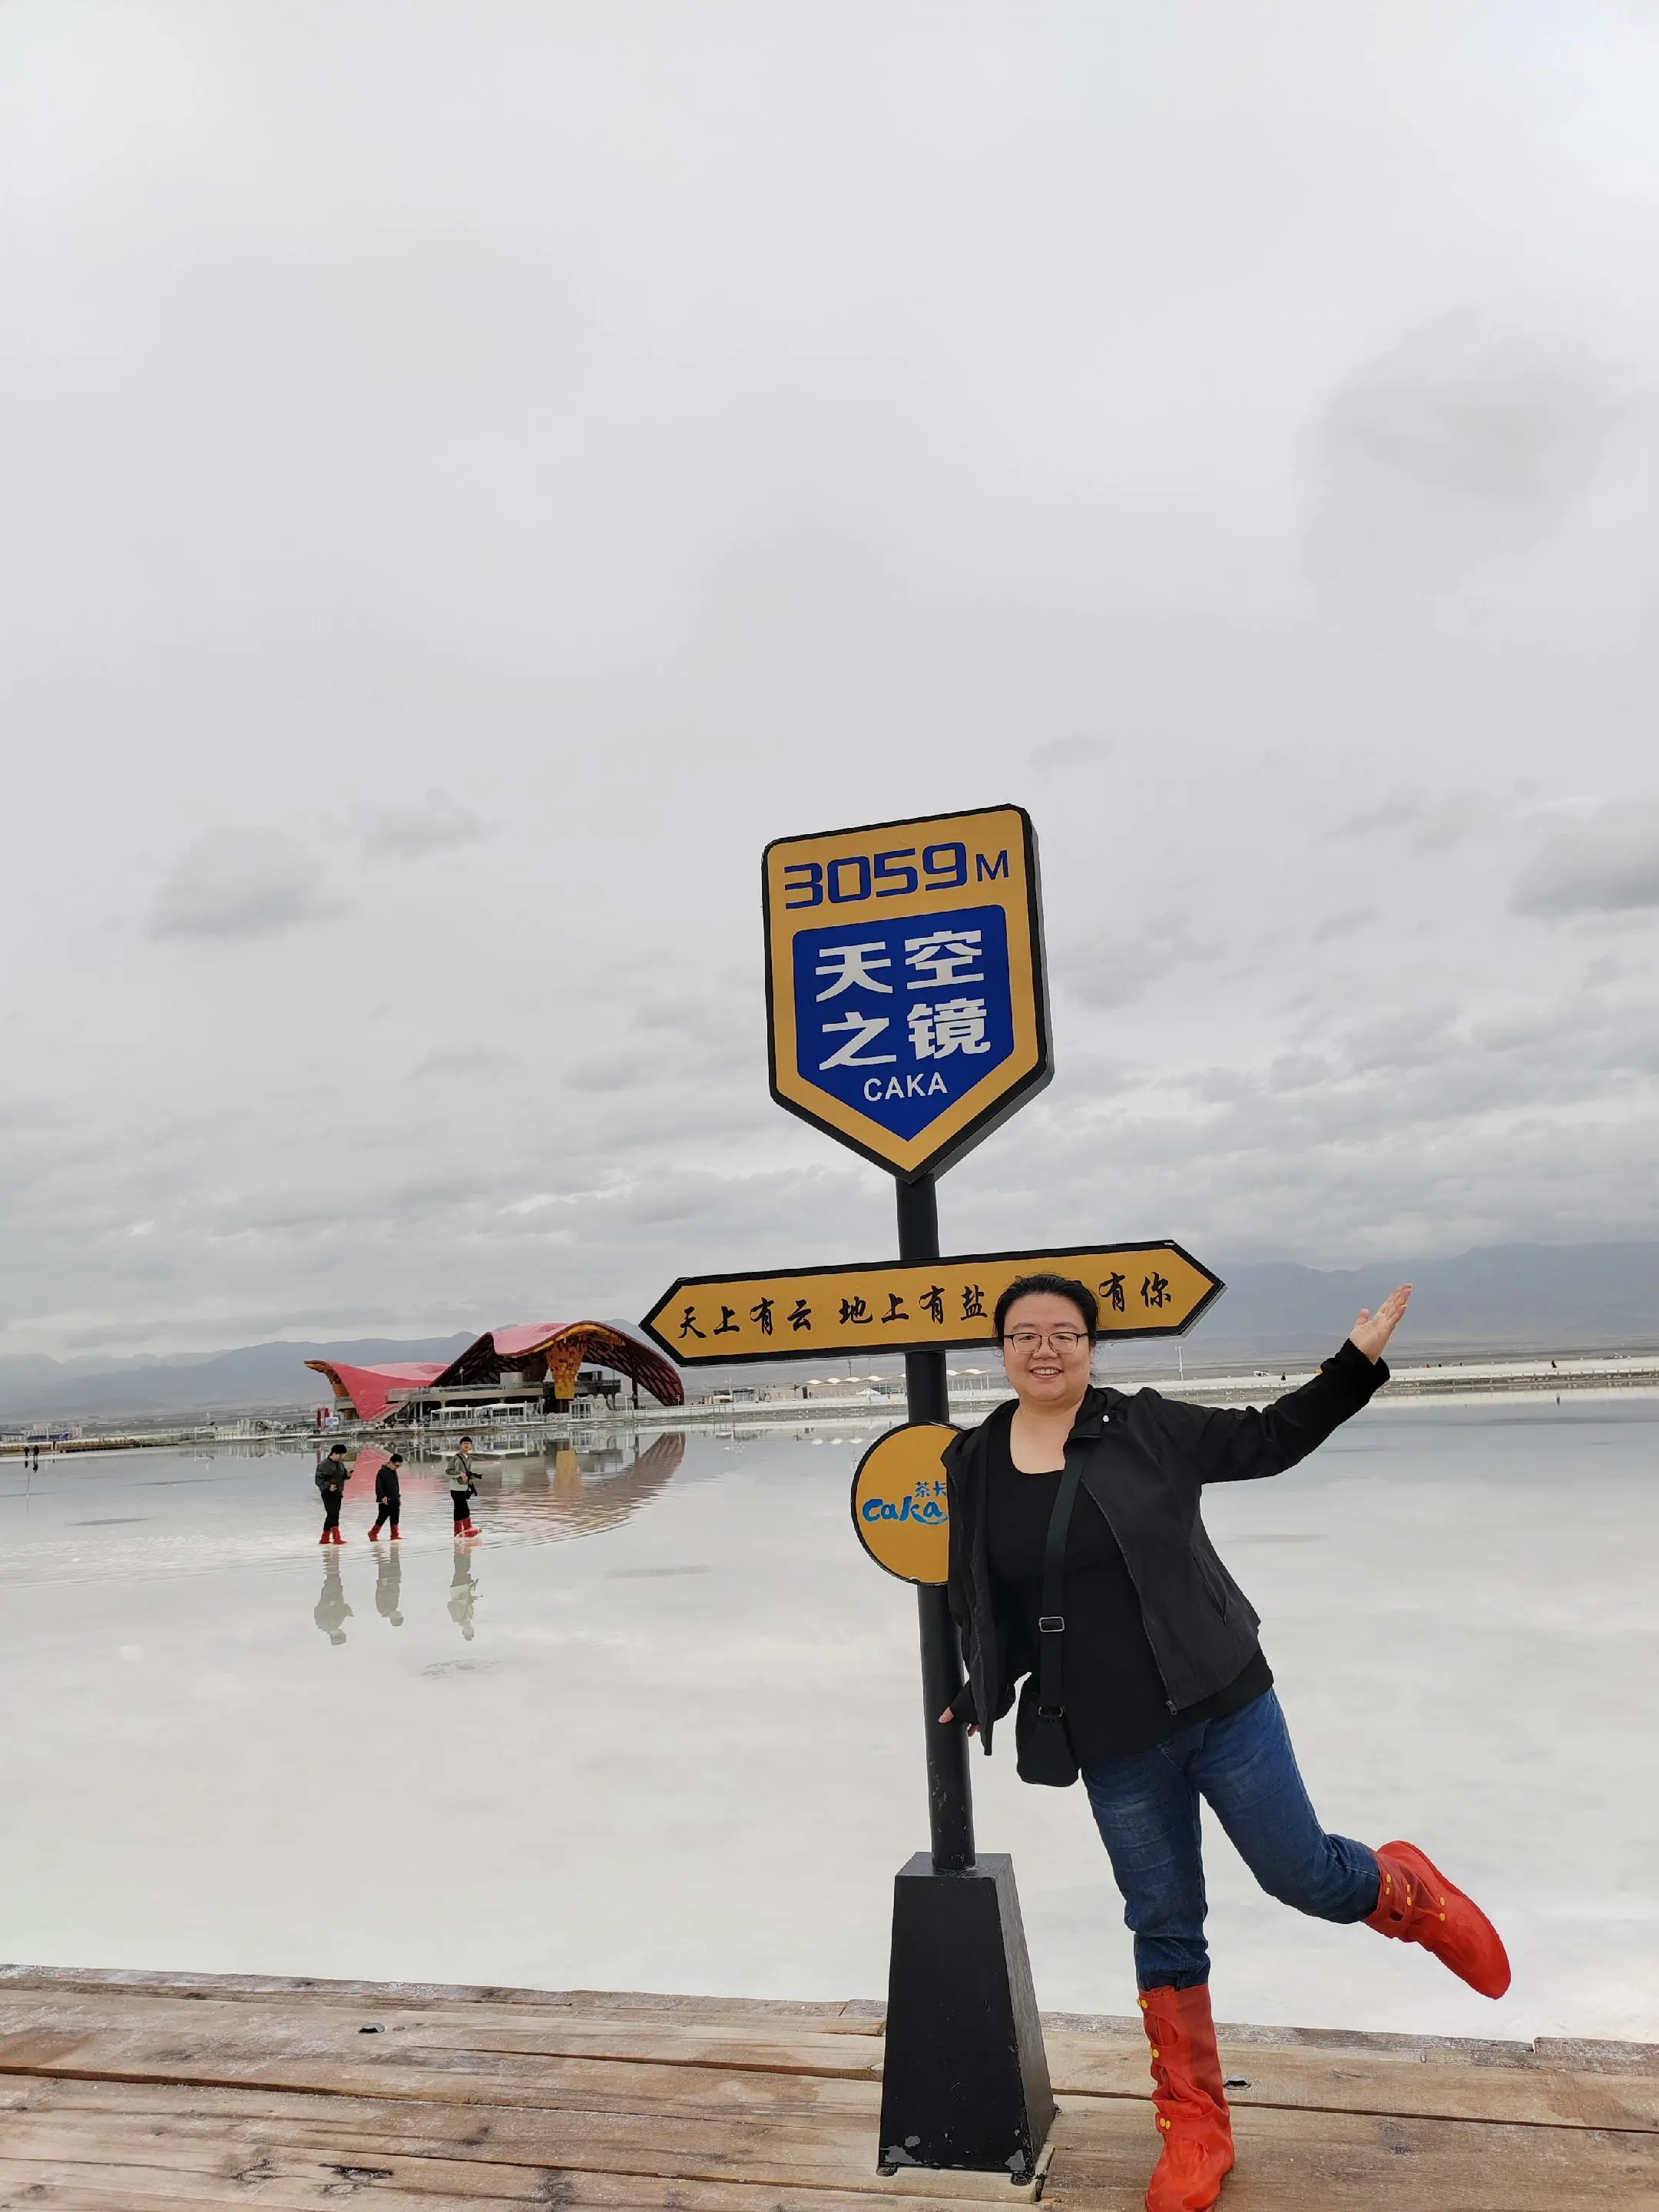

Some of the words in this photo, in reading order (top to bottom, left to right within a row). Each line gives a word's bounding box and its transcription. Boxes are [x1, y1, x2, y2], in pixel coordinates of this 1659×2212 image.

[815, 929, 985, 1002] 天空
[819, 998, 991, 1071] 之镜
[863, 1072, 948, 1101] CAKA
[677, 1296, 813, 1339] 天上有云
[1098, 1271, 1171, 1313] 有你
